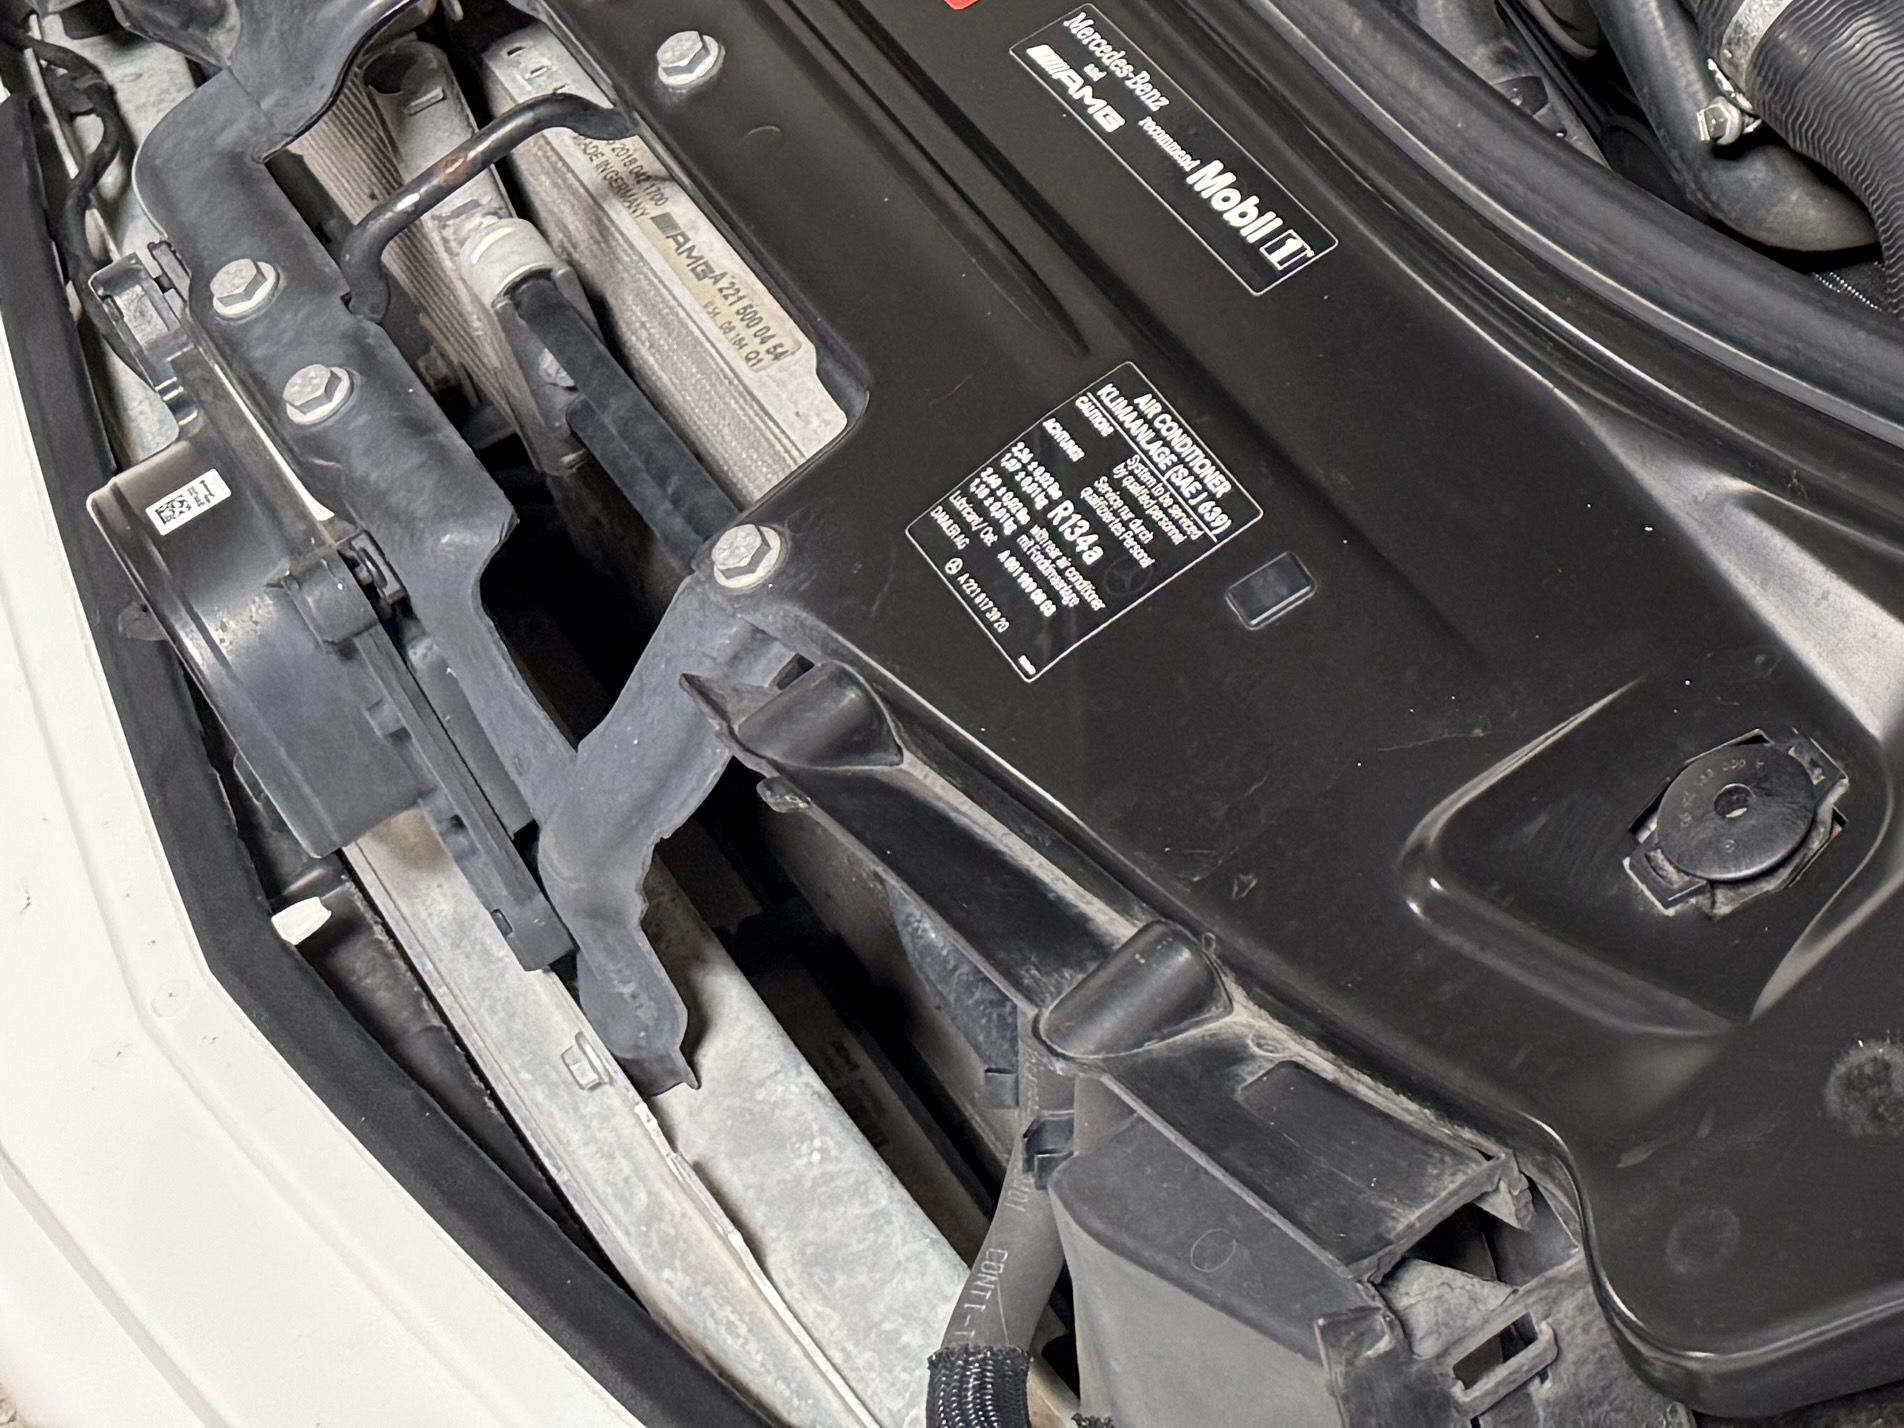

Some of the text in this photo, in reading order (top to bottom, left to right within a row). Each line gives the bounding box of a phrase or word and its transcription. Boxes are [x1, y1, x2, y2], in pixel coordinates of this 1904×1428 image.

[1064, 12, 1169, 111] Mercedes-Benz
[1084, 64, 1106, 81] and
[594, 155, 609, 175] IN
[602, 168, 650, 220] GERMANY
[1138, 117, 1200, 171] recommend
[1186, 160, 1283, 243] Mobil
[1097, 384, 1177, 470] KLIMAANLAGE
[1160, 464, 1202, 499] (SAE
[1190, 501, 1231, 539] 639)
[1134, 394, 1231, 498] AIR CONDITIONER
[931, 506, 969, 549] DAIMLER AG
[1047, 500, 1103, 565] R134a
[1081, 487, 1155, 568] qualifiziertes Personal
[1094, 476, 1153, 544] Service nur durch
[1113, 463, 1187, 545] by qualified personnel
[1122, 455, 1204, 540] System to be serviced
[998, 550, 1010, 562] A
[1065, 567, 1105, 611] conditioner
